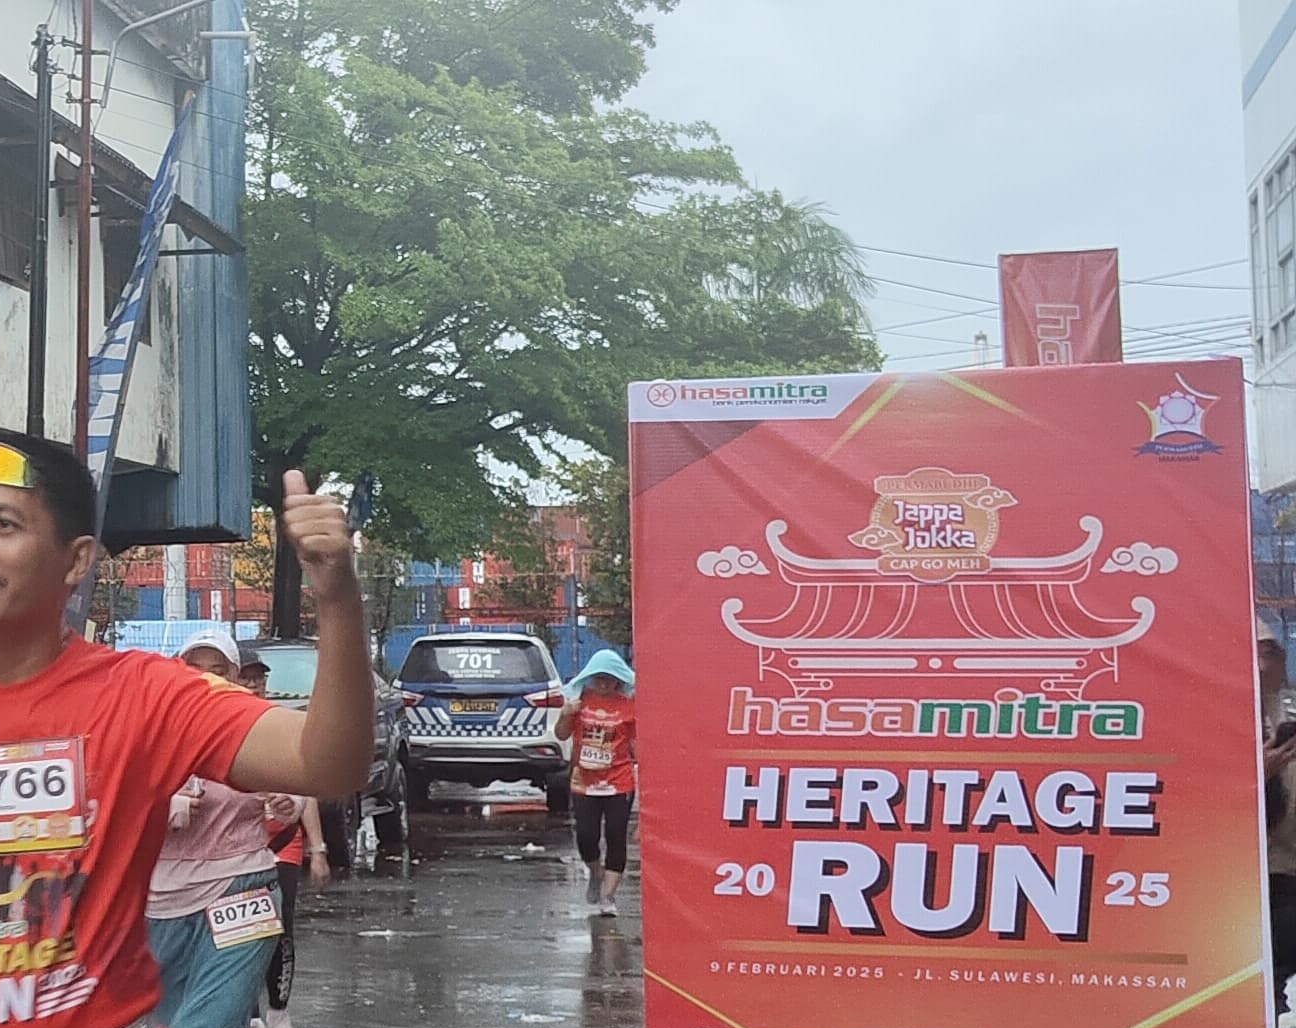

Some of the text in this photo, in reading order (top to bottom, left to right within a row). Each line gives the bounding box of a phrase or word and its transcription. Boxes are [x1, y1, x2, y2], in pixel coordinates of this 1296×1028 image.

[681, 383, 828, 400] hasamitra
[894, 500, 964, 528] Jappa
[904, 525, 976, 551] Jokka
[890, 559, 980, 569] CAP GO MEH
[456, 654, 492, 669] 701
[727, 685, 1144, 741] hasamitra
[722, 766, 1161, 833] HERITAGE
[714, 840, 1171, 938] 20 RUN 25
[212, 898, 272, 925] 80723
[710, 961, 720, 973] 9
[727, 962, 826, 977] FEBRUARI
[833, 966, 885, 979] 2025
[914, 969, 942, 981] JL.
[1072, 974, 1187, 989] MAKASSAR
